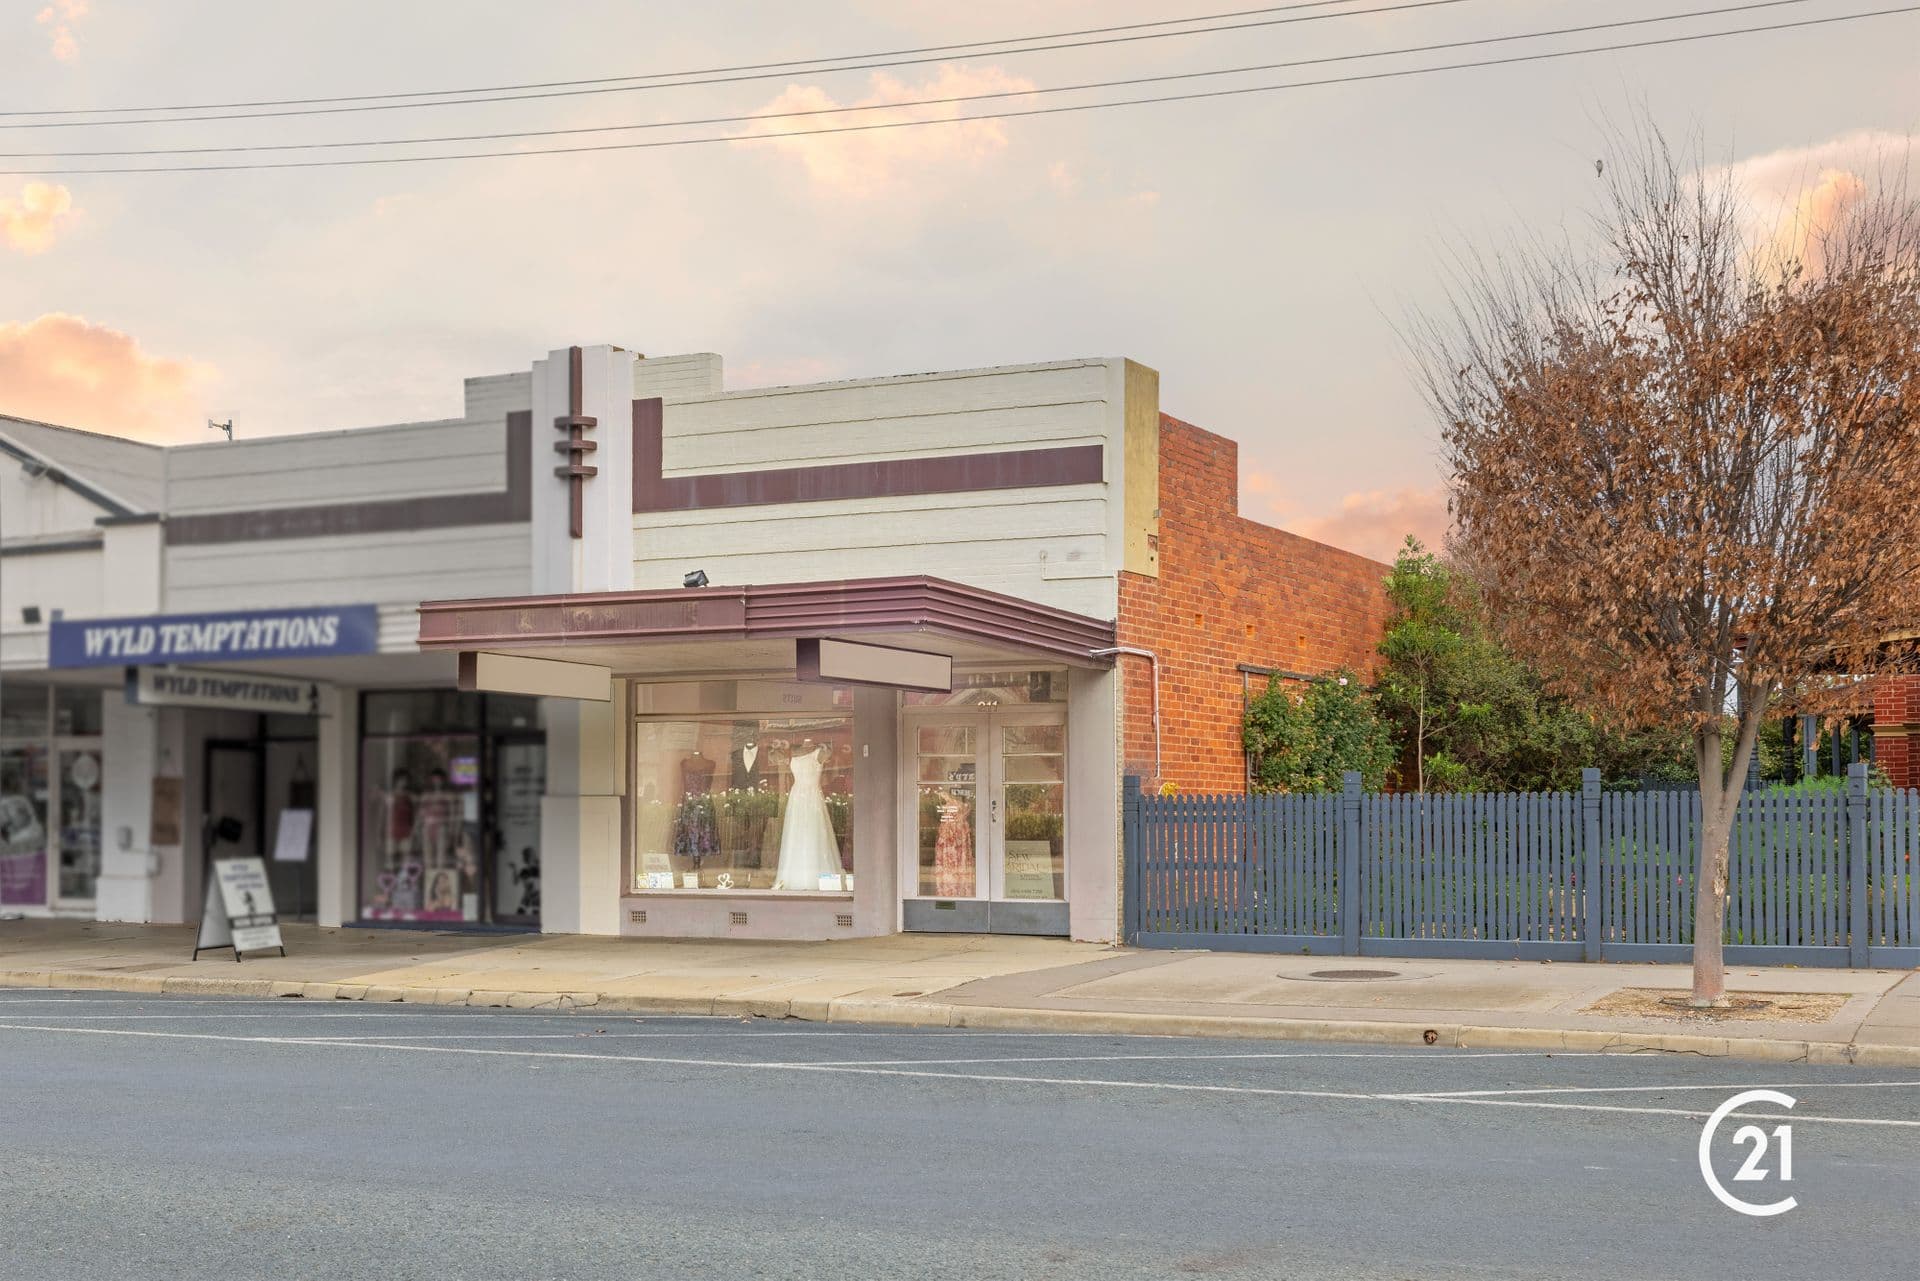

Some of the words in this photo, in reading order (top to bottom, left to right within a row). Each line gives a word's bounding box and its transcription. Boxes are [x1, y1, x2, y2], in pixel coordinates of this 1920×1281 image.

[85, 626, 155, 657] WYLD
[160, 616, 339, 653] TEMPTATIONS
[153, 675, 197, 695] WYLD
[202, 678, 298, 702] TEMPTATIONS
